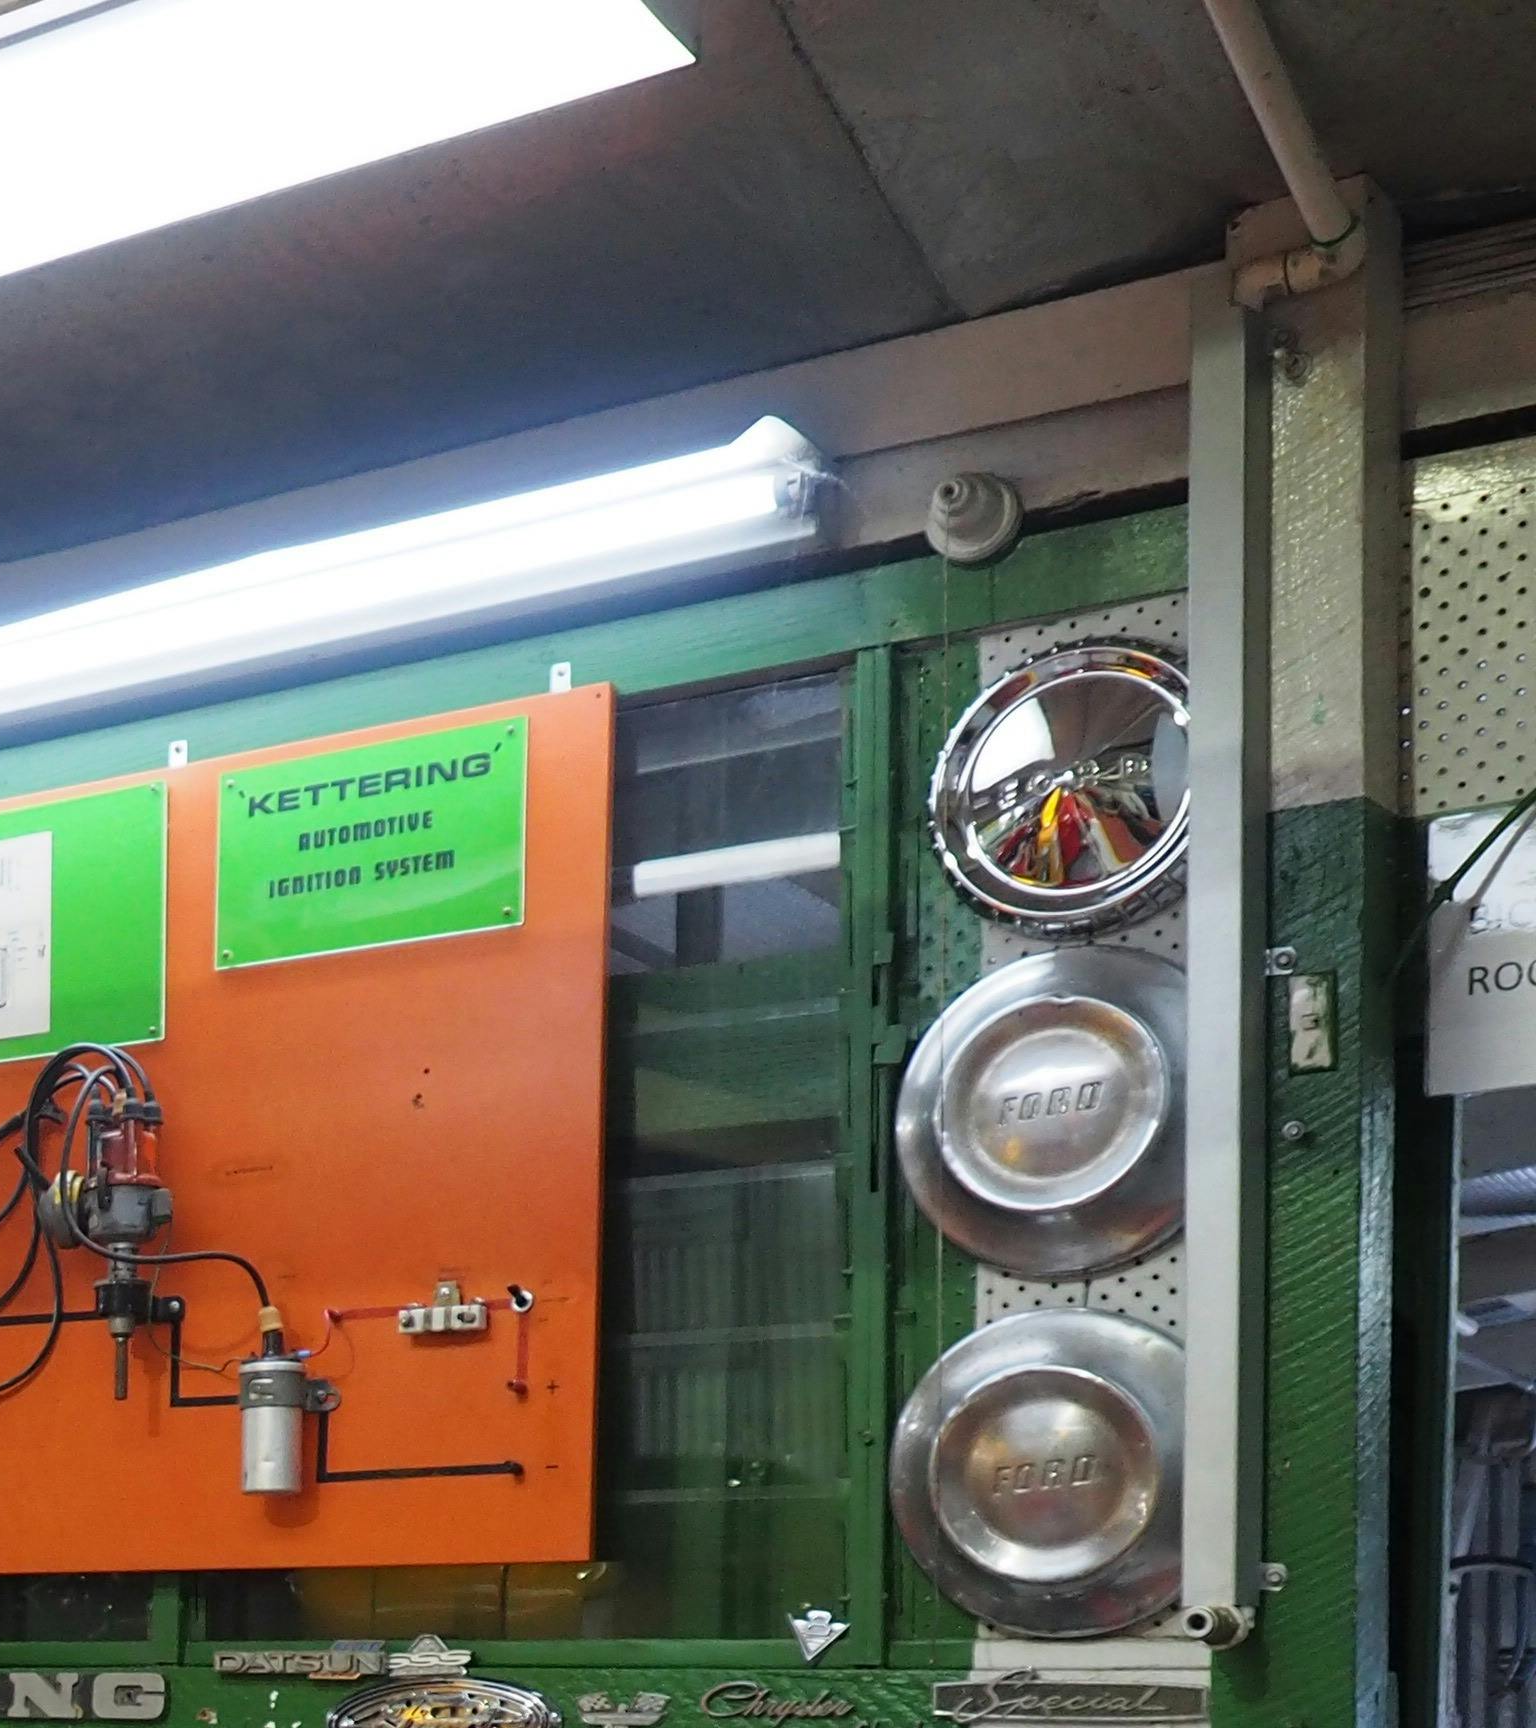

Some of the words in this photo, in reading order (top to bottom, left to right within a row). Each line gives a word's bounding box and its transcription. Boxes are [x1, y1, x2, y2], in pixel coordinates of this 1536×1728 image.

[298, 810, 433, 851] AUTOMOTIVE
[268, 866, 362, 898] IGNITION
[374, 849, 455, 881] SYSTEM
[997, 1081, 1104, 1127] FORD
[992, 1455, 1098, 1496] FORD
[215, 1651, 385, 1674] DATSUN
[389, 1649, 472, 1669] SSS
[701, 1680, 855, 1725] Chrysler
[953, 1666, 1168, 1723] Special
